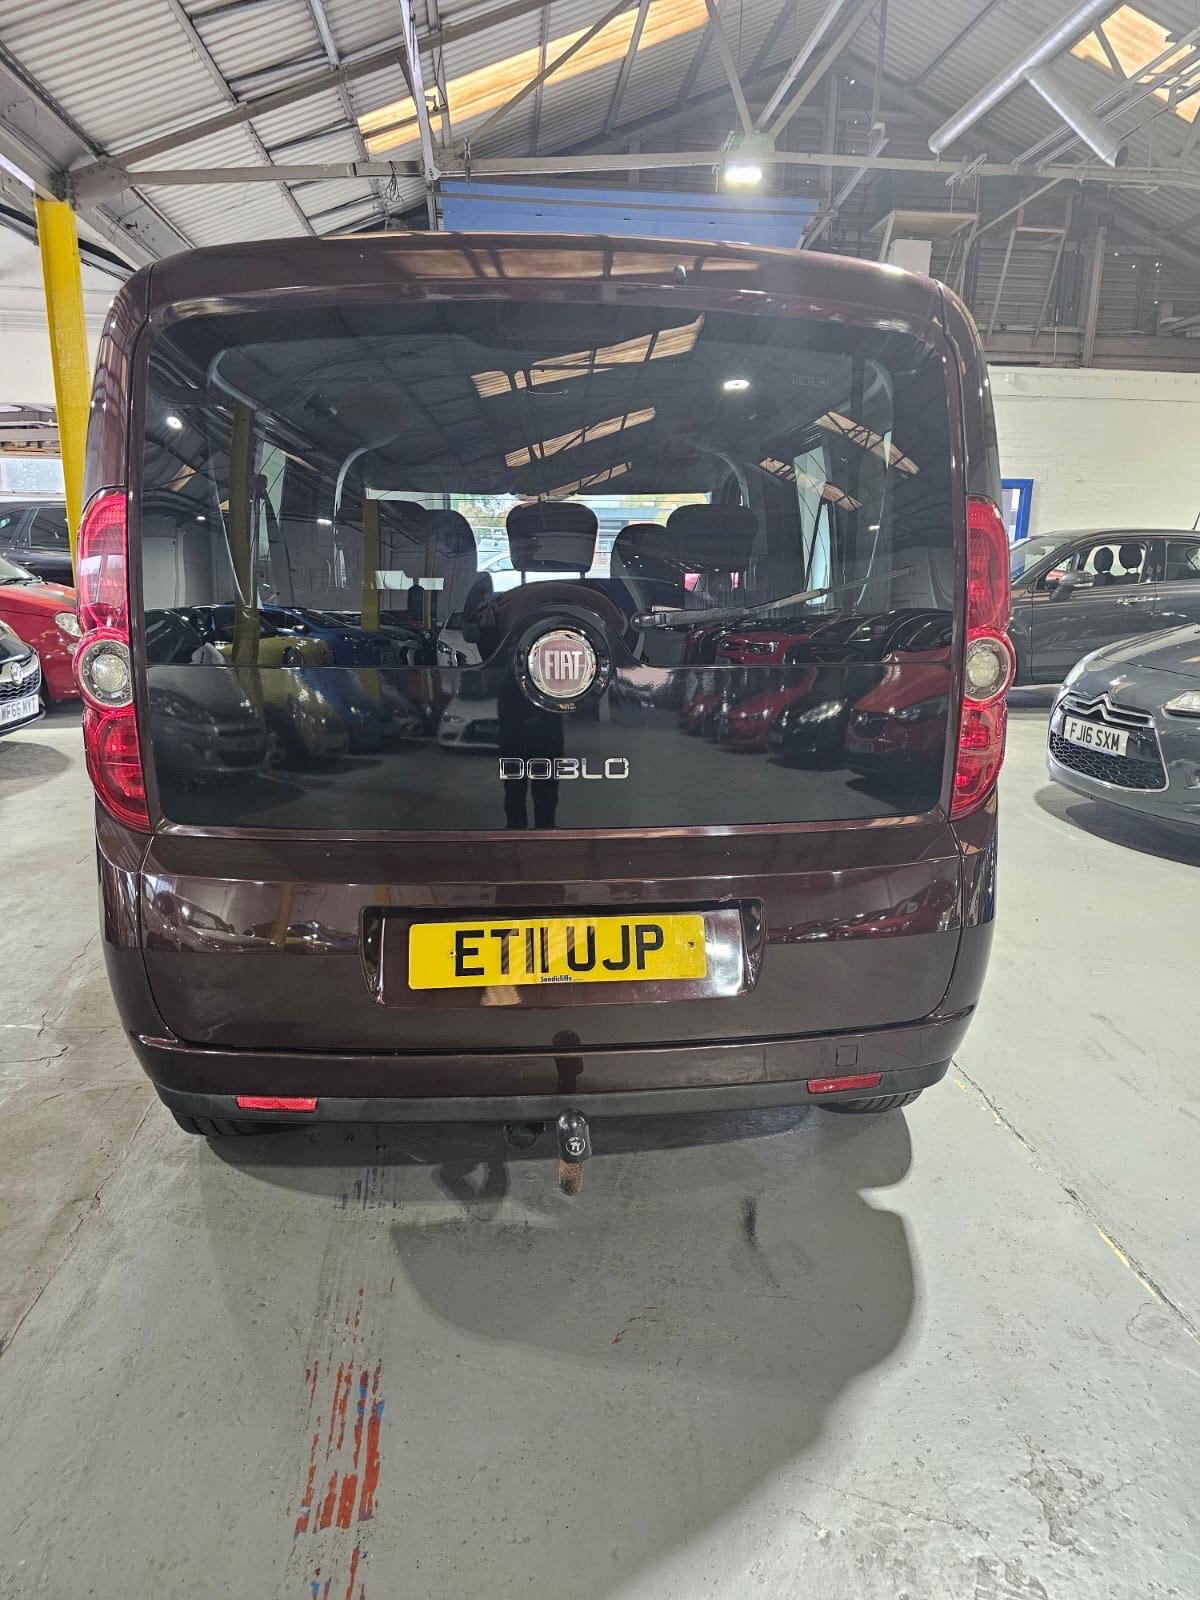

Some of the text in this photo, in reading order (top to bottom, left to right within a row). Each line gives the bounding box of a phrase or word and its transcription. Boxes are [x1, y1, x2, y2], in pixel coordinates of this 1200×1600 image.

[544, 650, 582, 680] FIAT
[1070, 722, 1120, 751] FJ16 SXM
[499, 758, 629, 779] DOBLO
[455, 924, 665, 977] ET11 UJP
[540, 975, 572, 983] Sandicliffe
